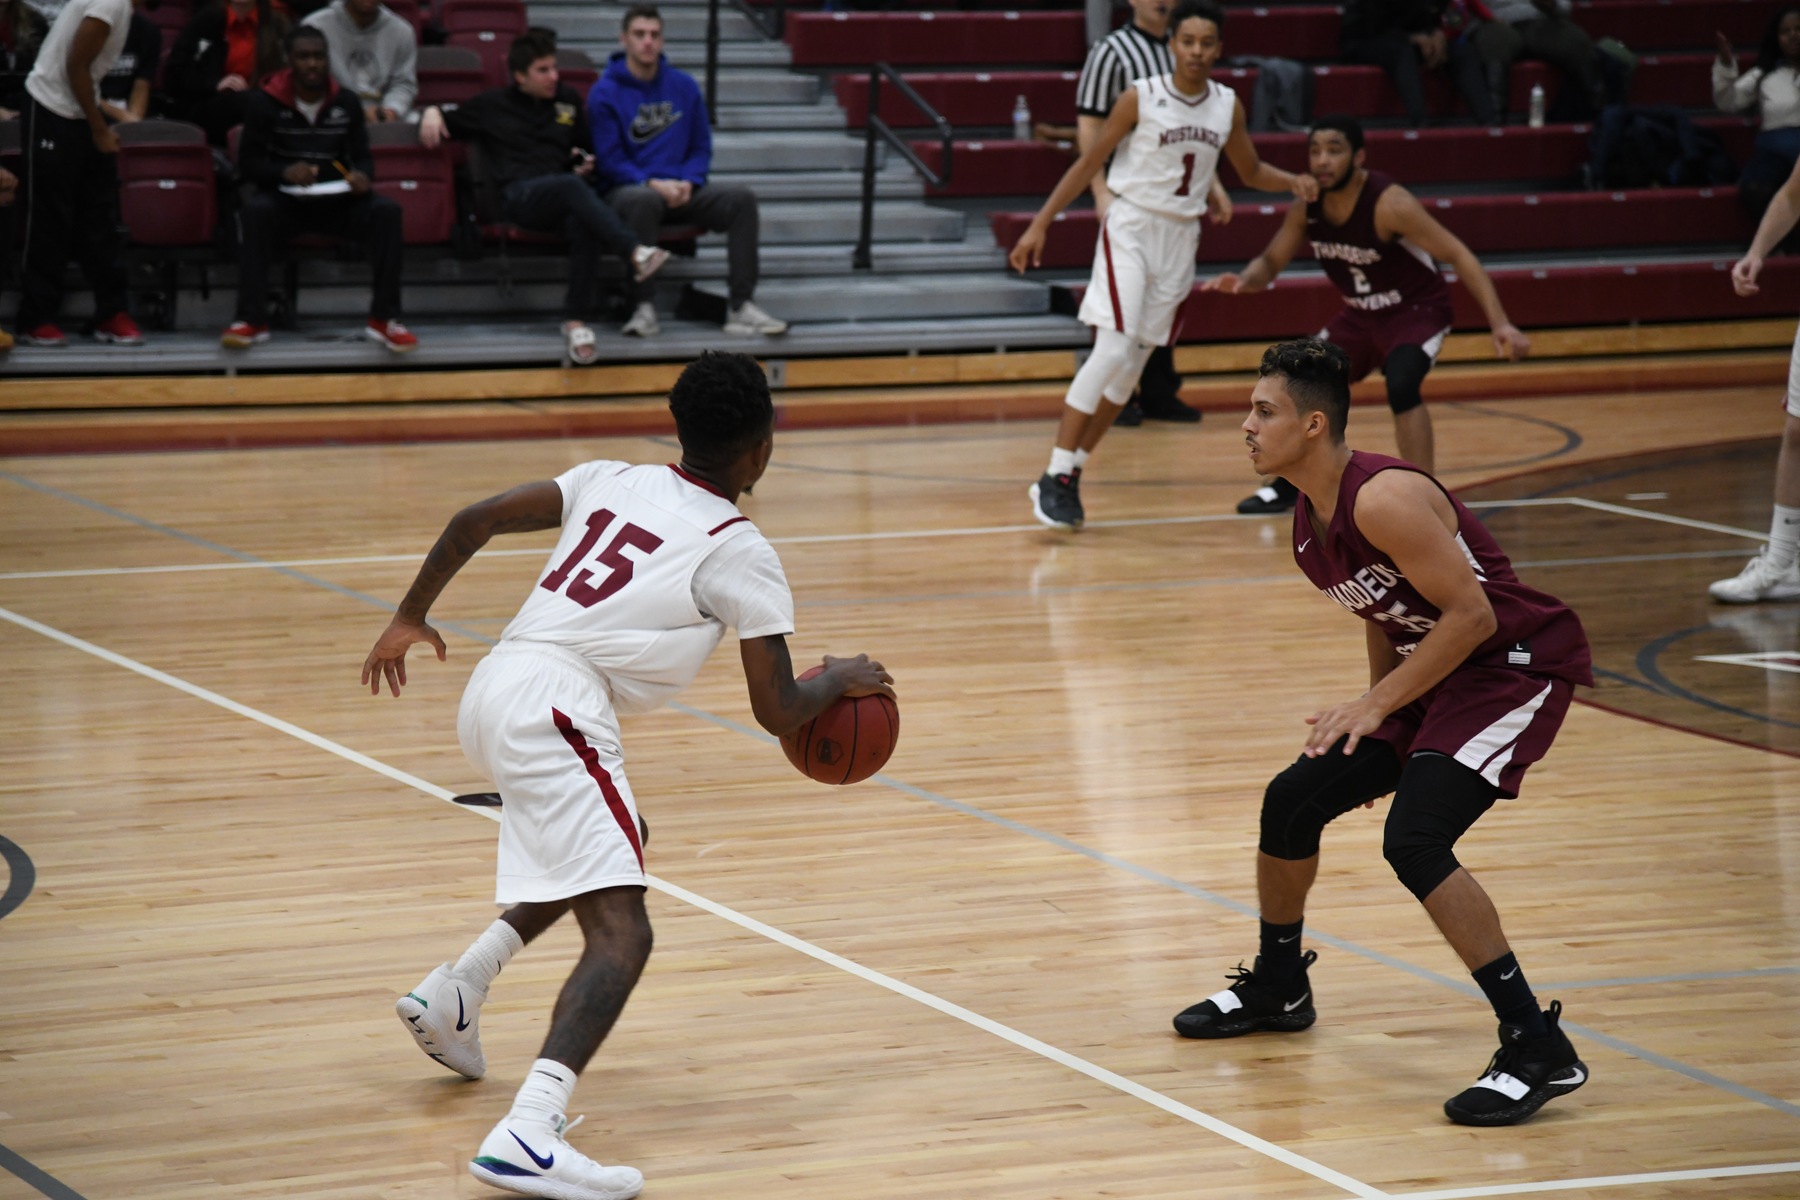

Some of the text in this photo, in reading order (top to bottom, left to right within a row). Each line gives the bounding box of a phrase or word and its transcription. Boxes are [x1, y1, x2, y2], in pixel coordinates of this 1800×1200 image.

[1174, 152, 1196, 196] 1
[1310, 241, 1382, 265] THADDEUS
[1349, 266, 1372, 293] 2
[540, 508, 664, 609] 15
[1322, 563, 1405, 612] HADDEU
